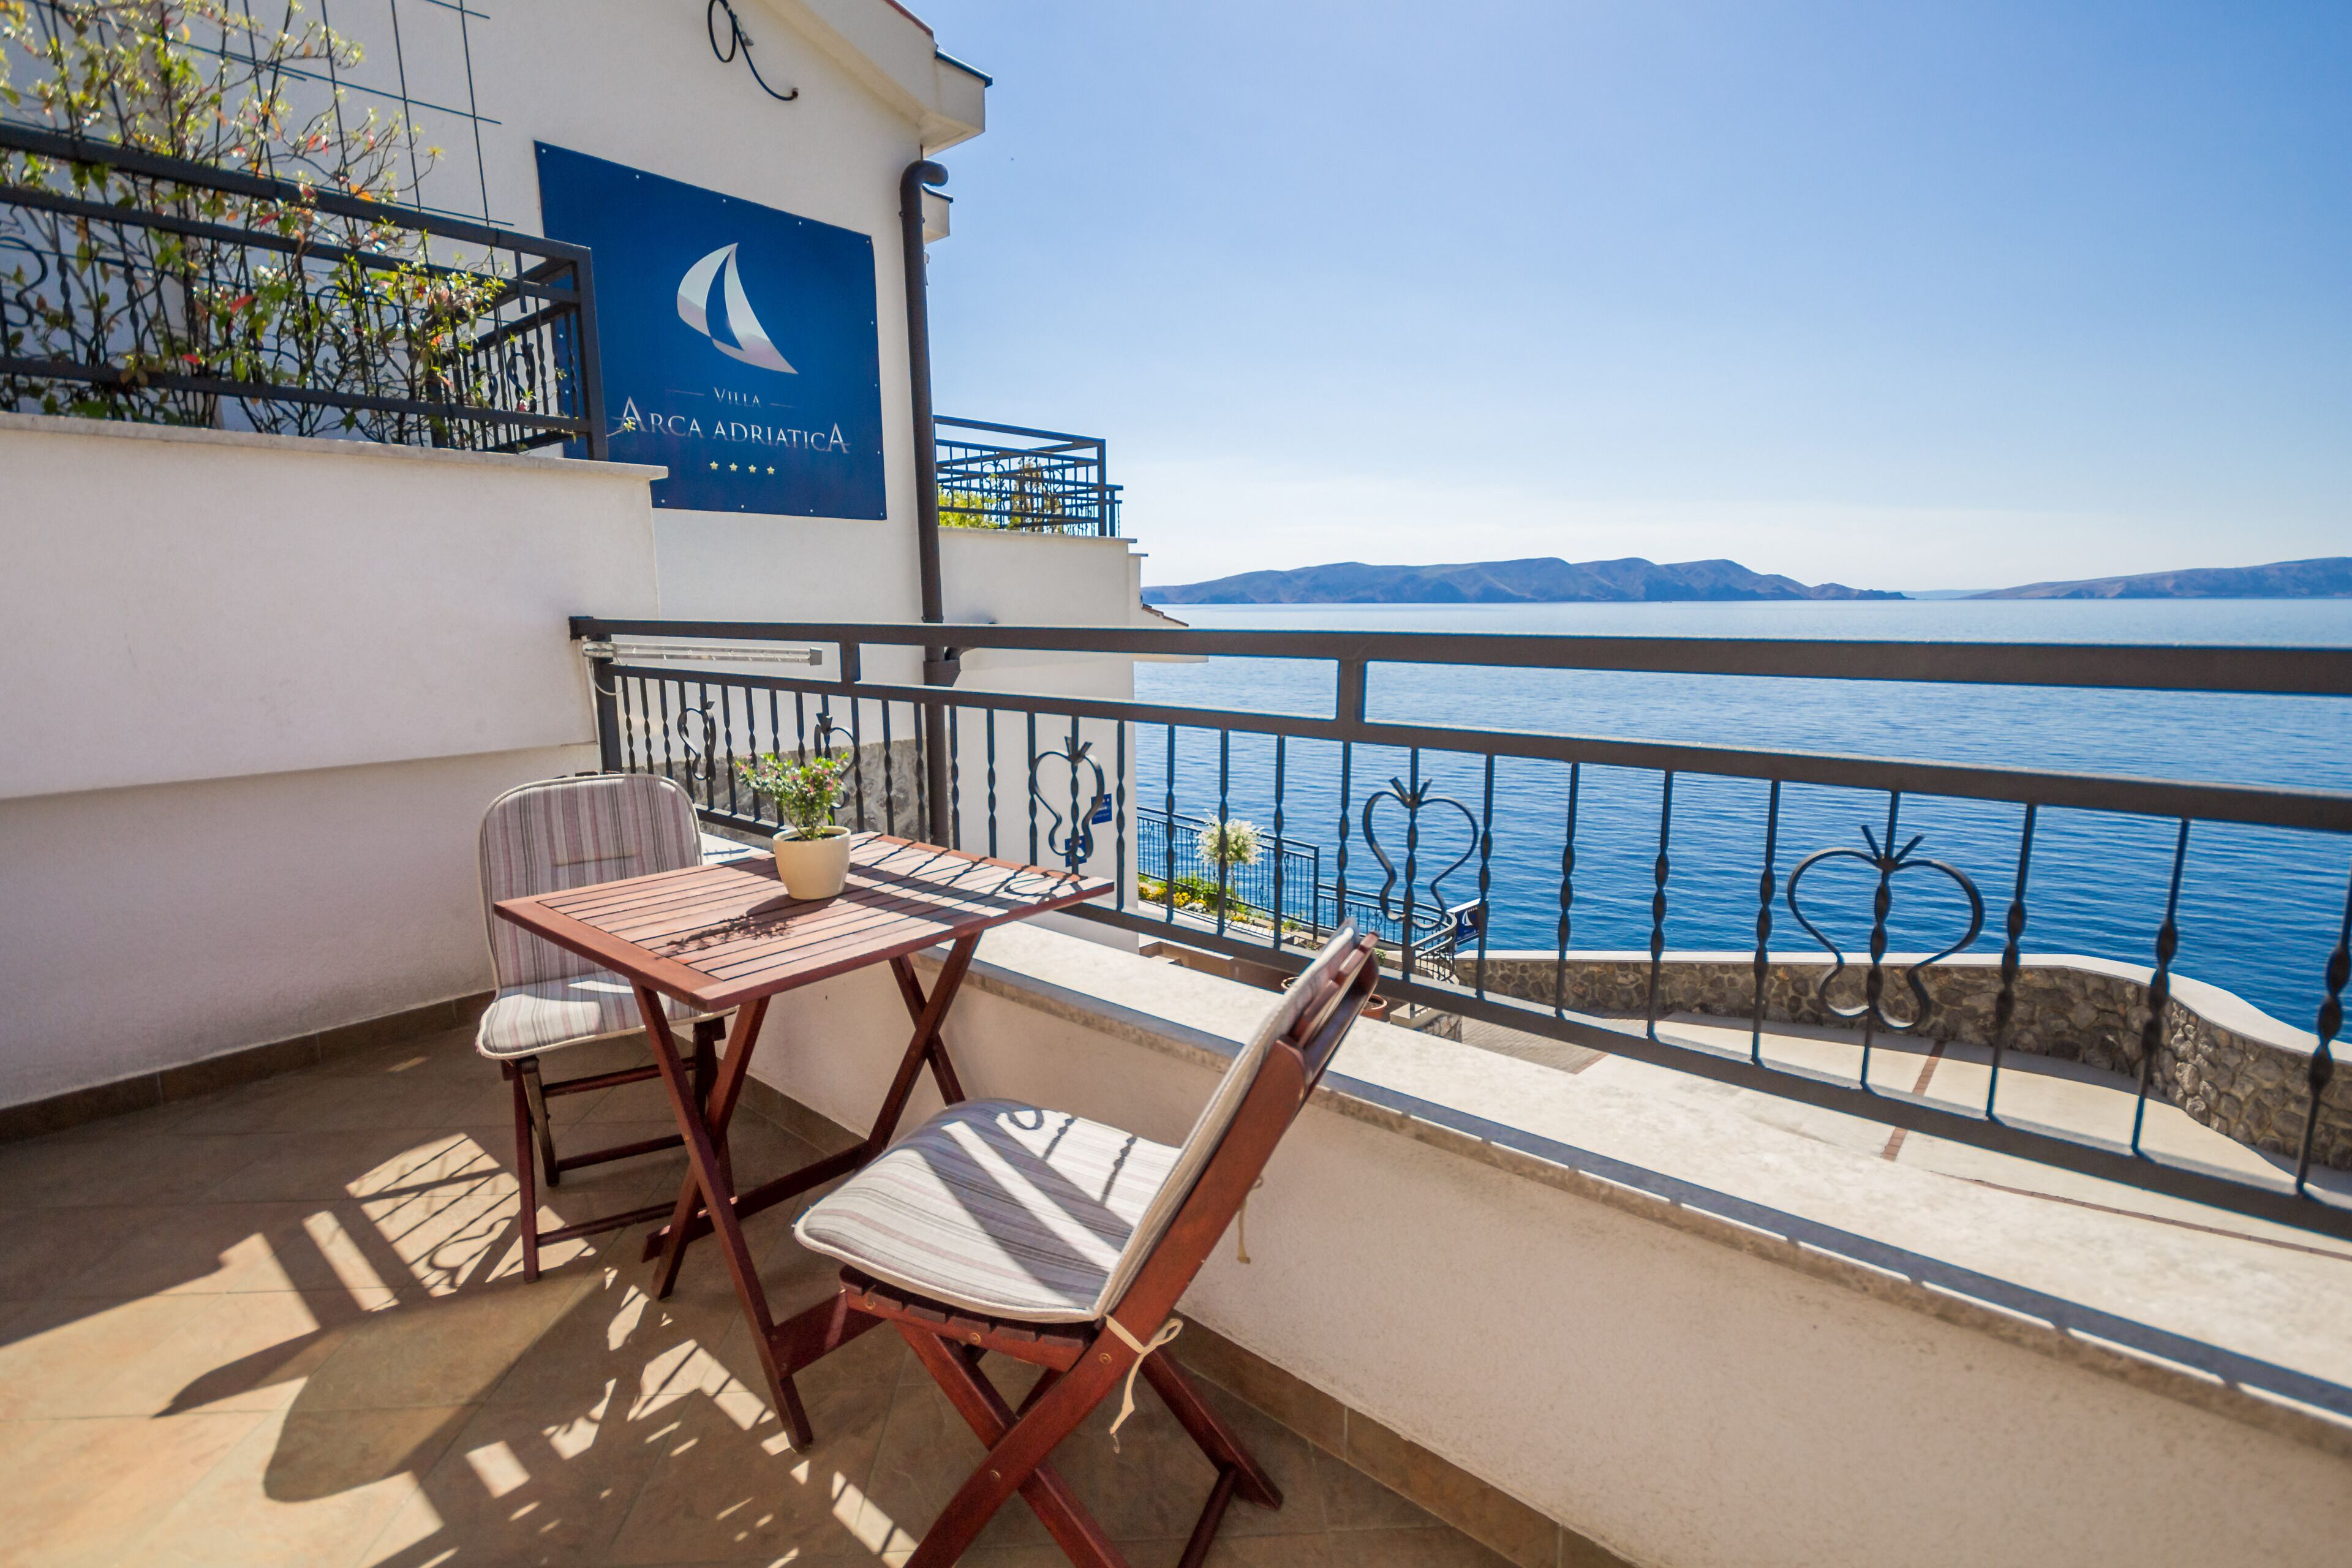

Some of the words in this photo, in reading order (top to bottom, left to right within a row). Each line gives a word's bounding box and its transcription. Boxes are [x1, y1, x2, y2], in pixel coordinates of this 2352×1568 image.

[714, 387, 761, 408] VILLA
[611, 396, 704, 439] ARCA
[712, 420, 851, 454] ADRIATICA
